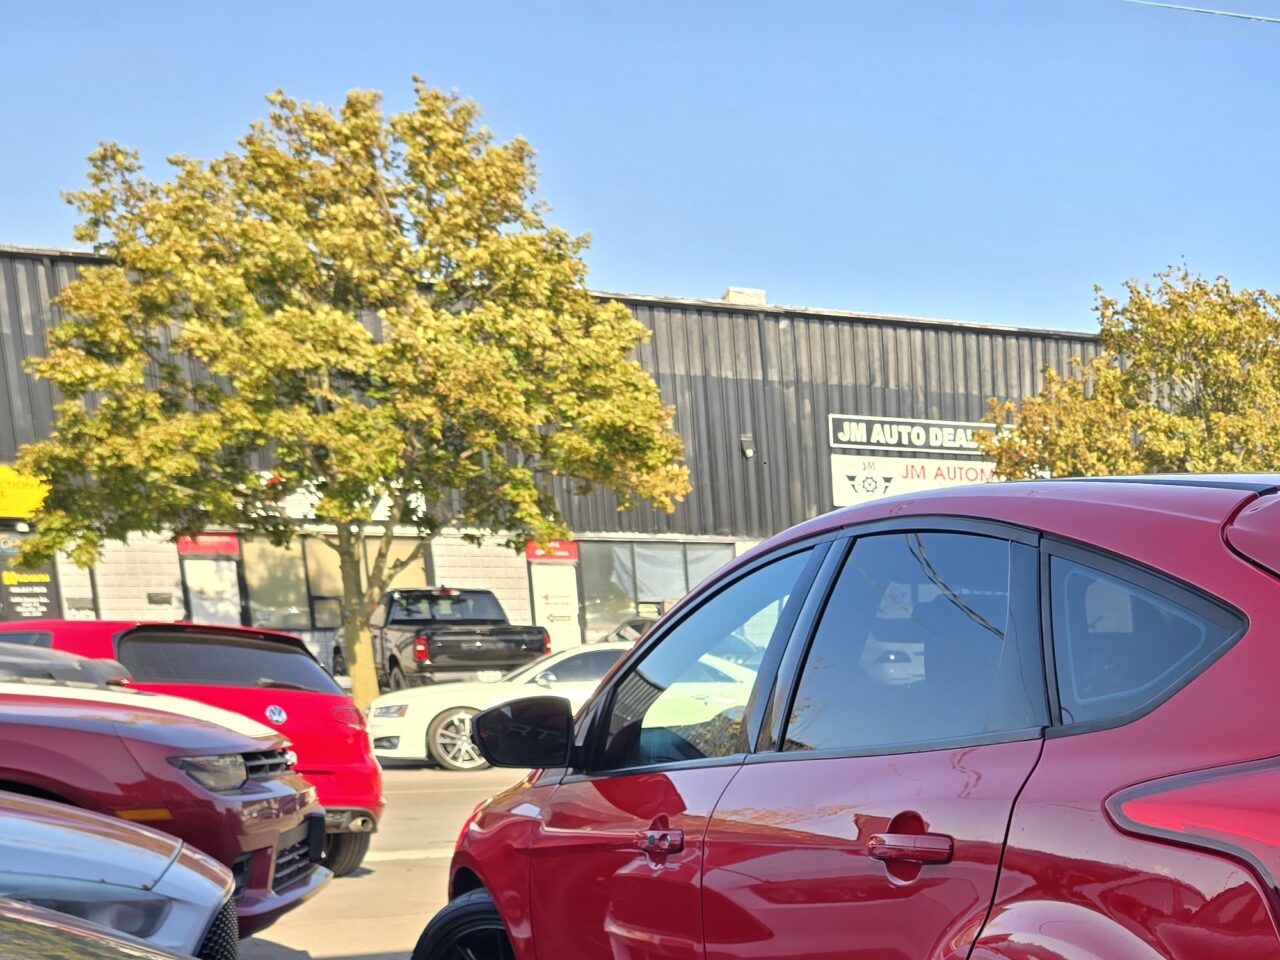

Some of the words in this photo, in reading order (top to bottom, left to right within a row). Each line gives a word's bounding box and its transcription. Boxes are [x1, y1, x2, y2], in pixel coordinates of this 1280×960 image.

[837, 421, 867, 443] JM
[870, 424, 926, 446] AUTO
[902, 464, 926, 479] JM
